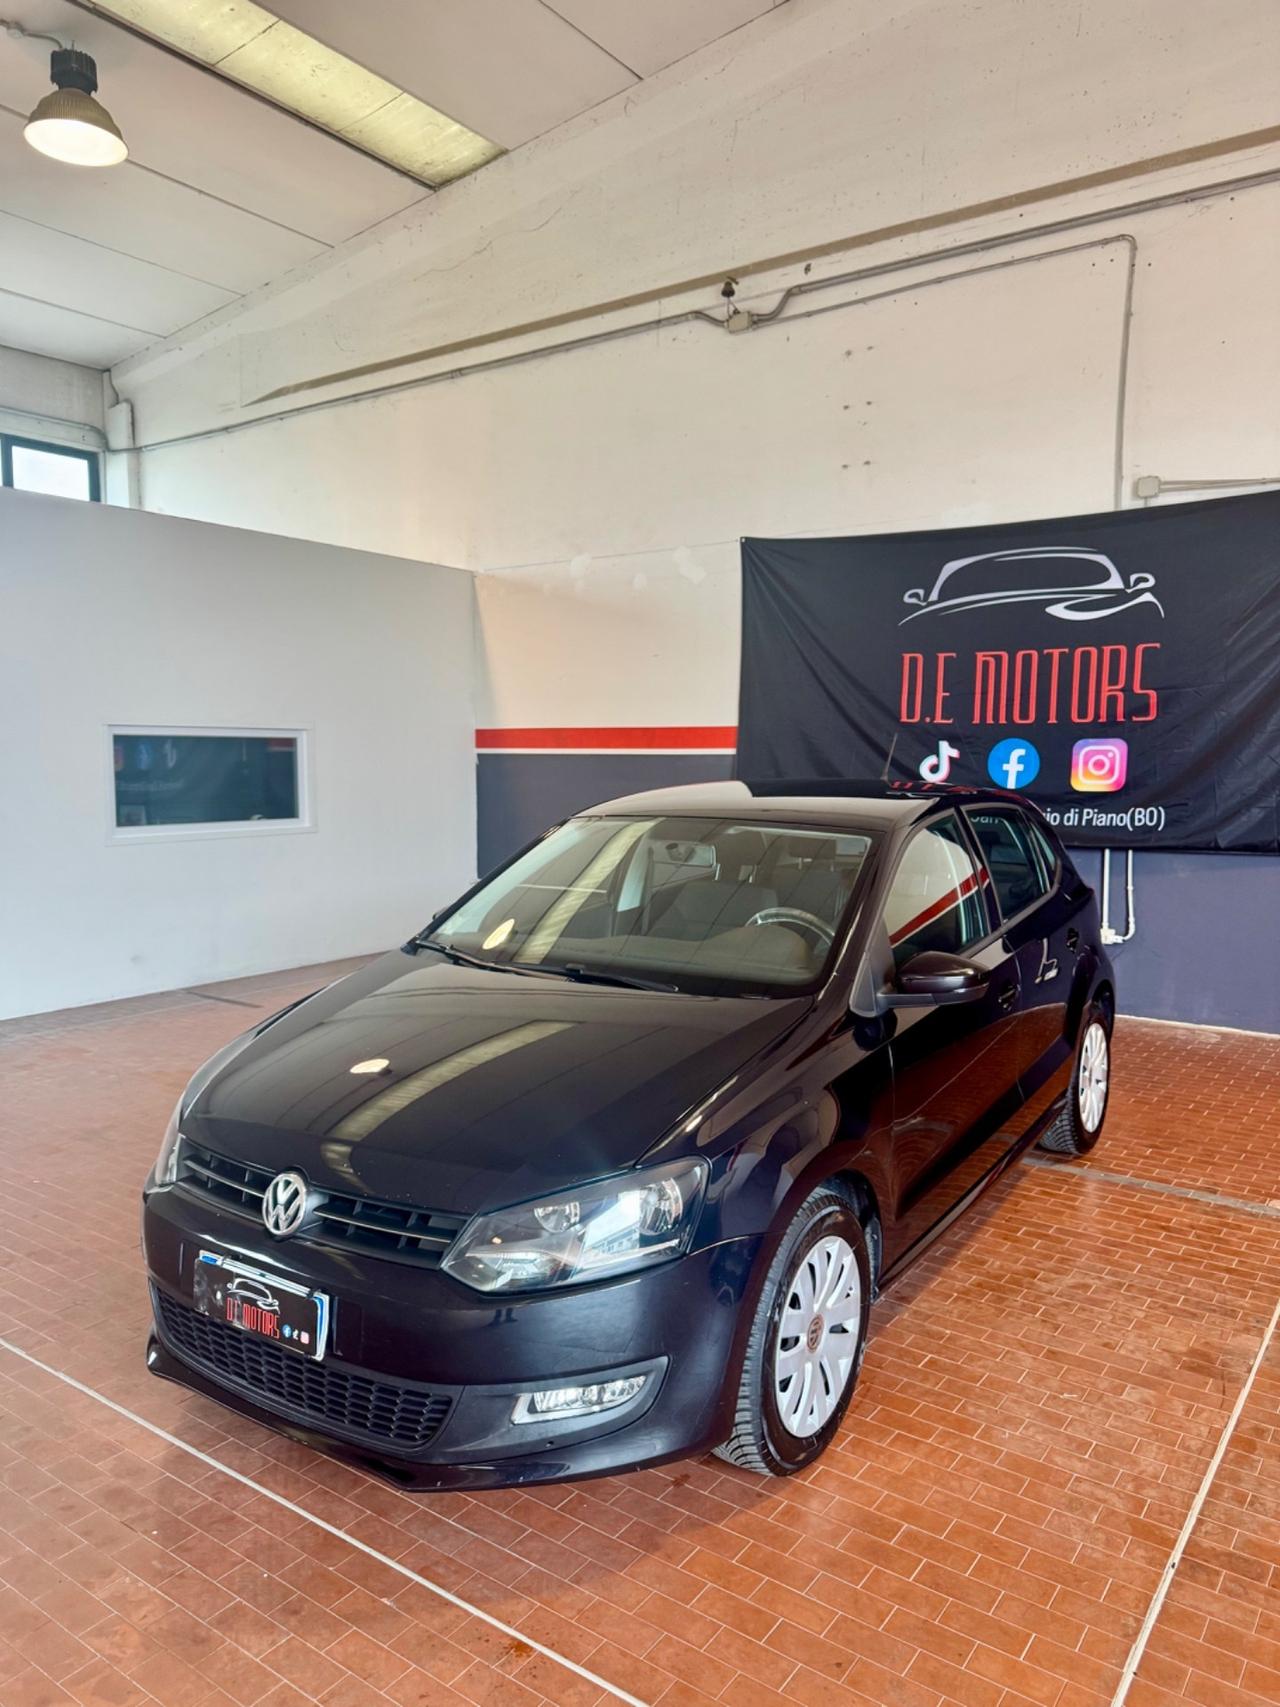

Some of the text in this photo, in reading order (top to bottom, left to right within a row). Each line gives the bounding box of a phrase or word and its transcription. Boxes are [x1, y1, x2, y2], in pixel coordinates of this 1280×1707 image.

[900, 643, 1160, 724] D.E MOTORS
[1063, 808, 1079, 826] di
[1081, 806, 1165, 832] Piano(BO)
[242, 1303, 280, 1339] MOTORS
